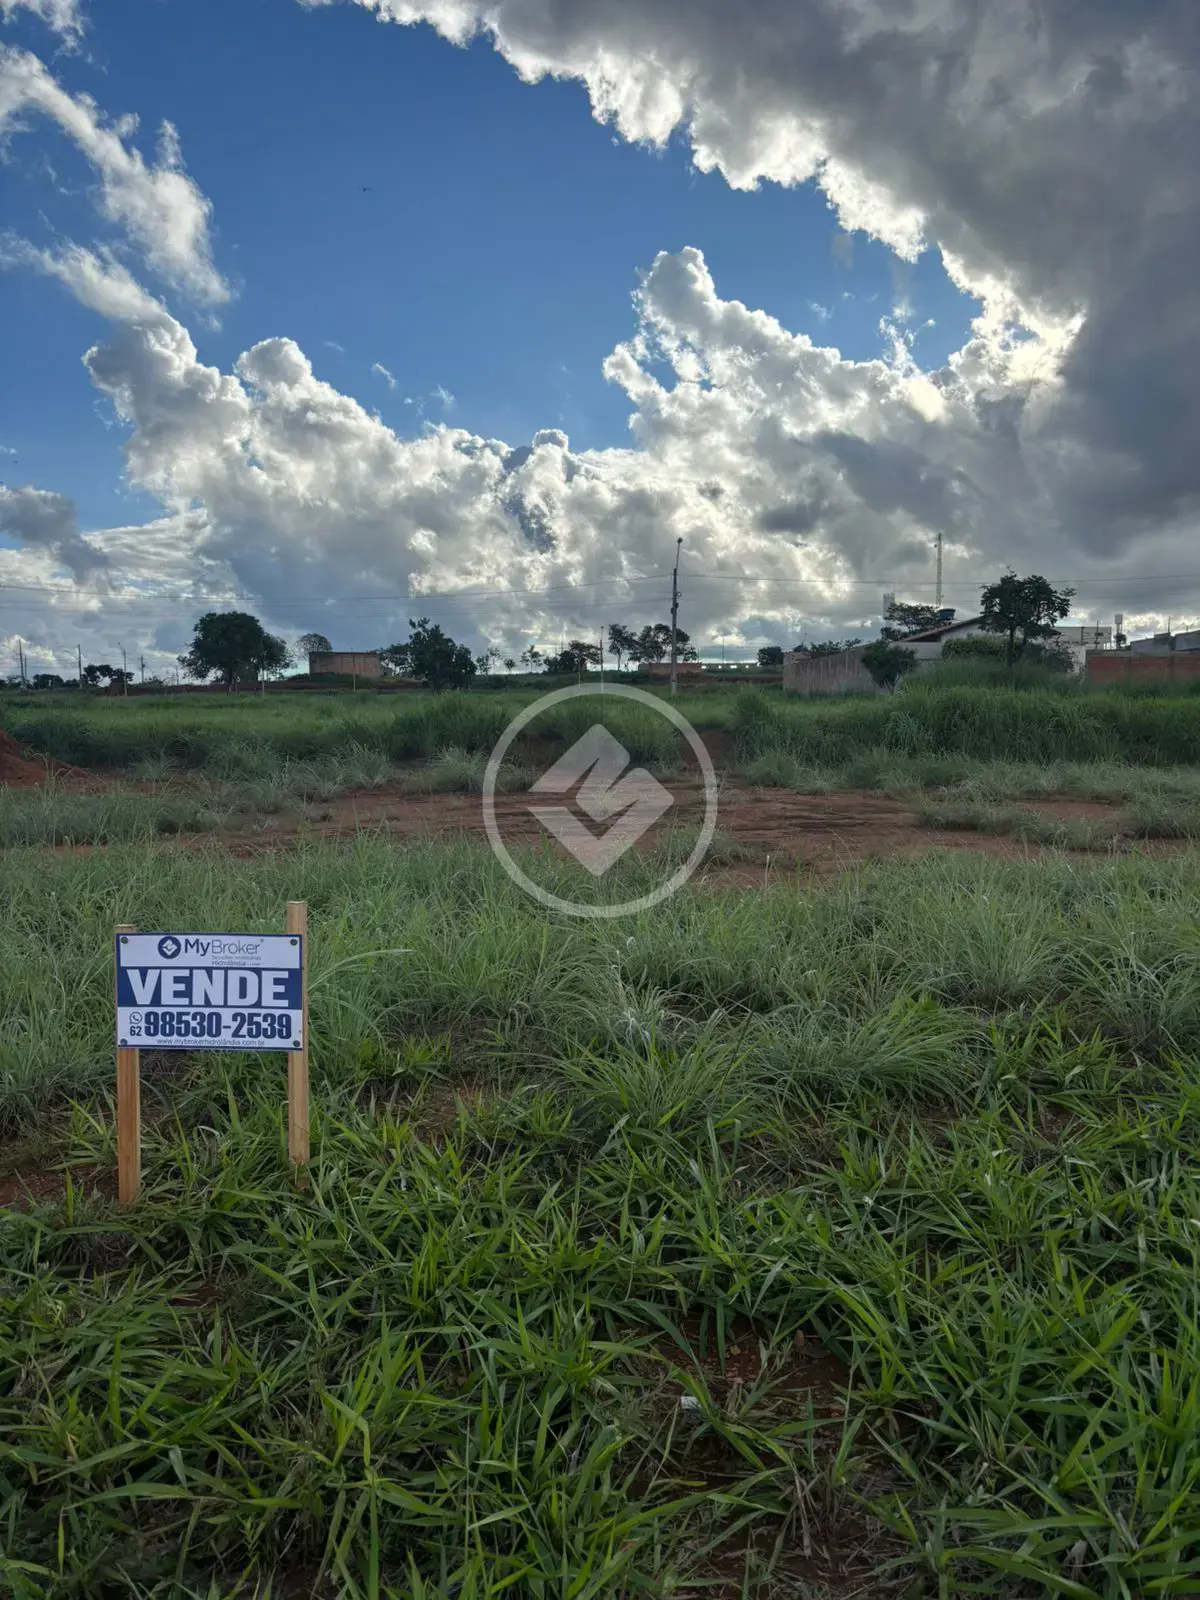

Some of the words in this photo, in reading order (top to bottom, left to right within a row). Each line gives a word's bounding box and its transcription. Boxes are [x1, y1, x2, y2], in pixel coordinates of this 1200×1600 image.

[185, 938, 260, 956] MyBroker
[126, 968, 289, 1007] VENDE
[130, 1026, 142, 1037] 62
[144, 1011, 292, 1039] 98530-2539
